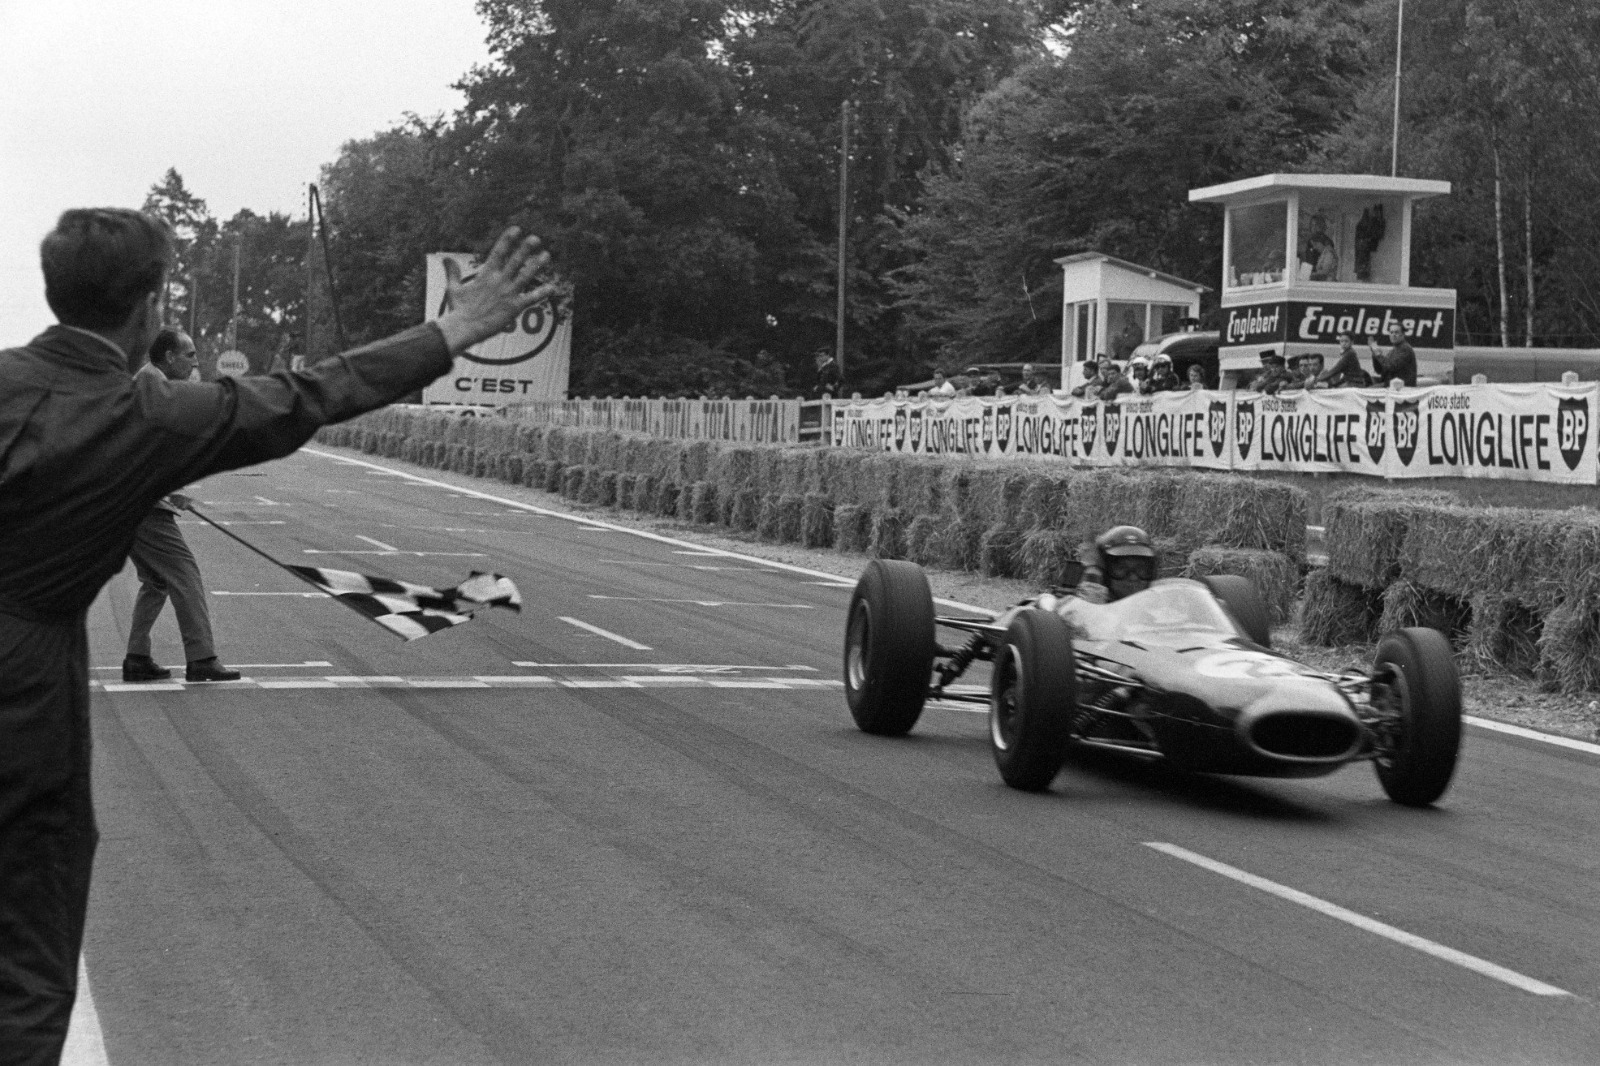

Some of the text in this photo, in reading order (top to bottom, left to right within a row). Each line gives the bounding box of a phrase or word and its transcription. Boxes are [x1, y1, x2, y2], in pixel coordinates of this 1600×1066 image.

[1226, 305, 1280, 343] Englebert
[455, 377, 533, 394] C'EST
[926, 418, 979, 454] LONGLIFE
[1016, 415, 1079, 457] LONGLIFE
[1082, 415, 1096, 443] BP
[1105, 410, 1225, 459] BP LONGLIFE BP
[1238, 412, 1252, 444] BP
[1261, 413, 1361, 463] LONGLIFE
[1396, 411, 1417, 448] BP
[1427, 411, 1550, 470] LONGLIFE
[1561, 409, 1586, 450] BP
